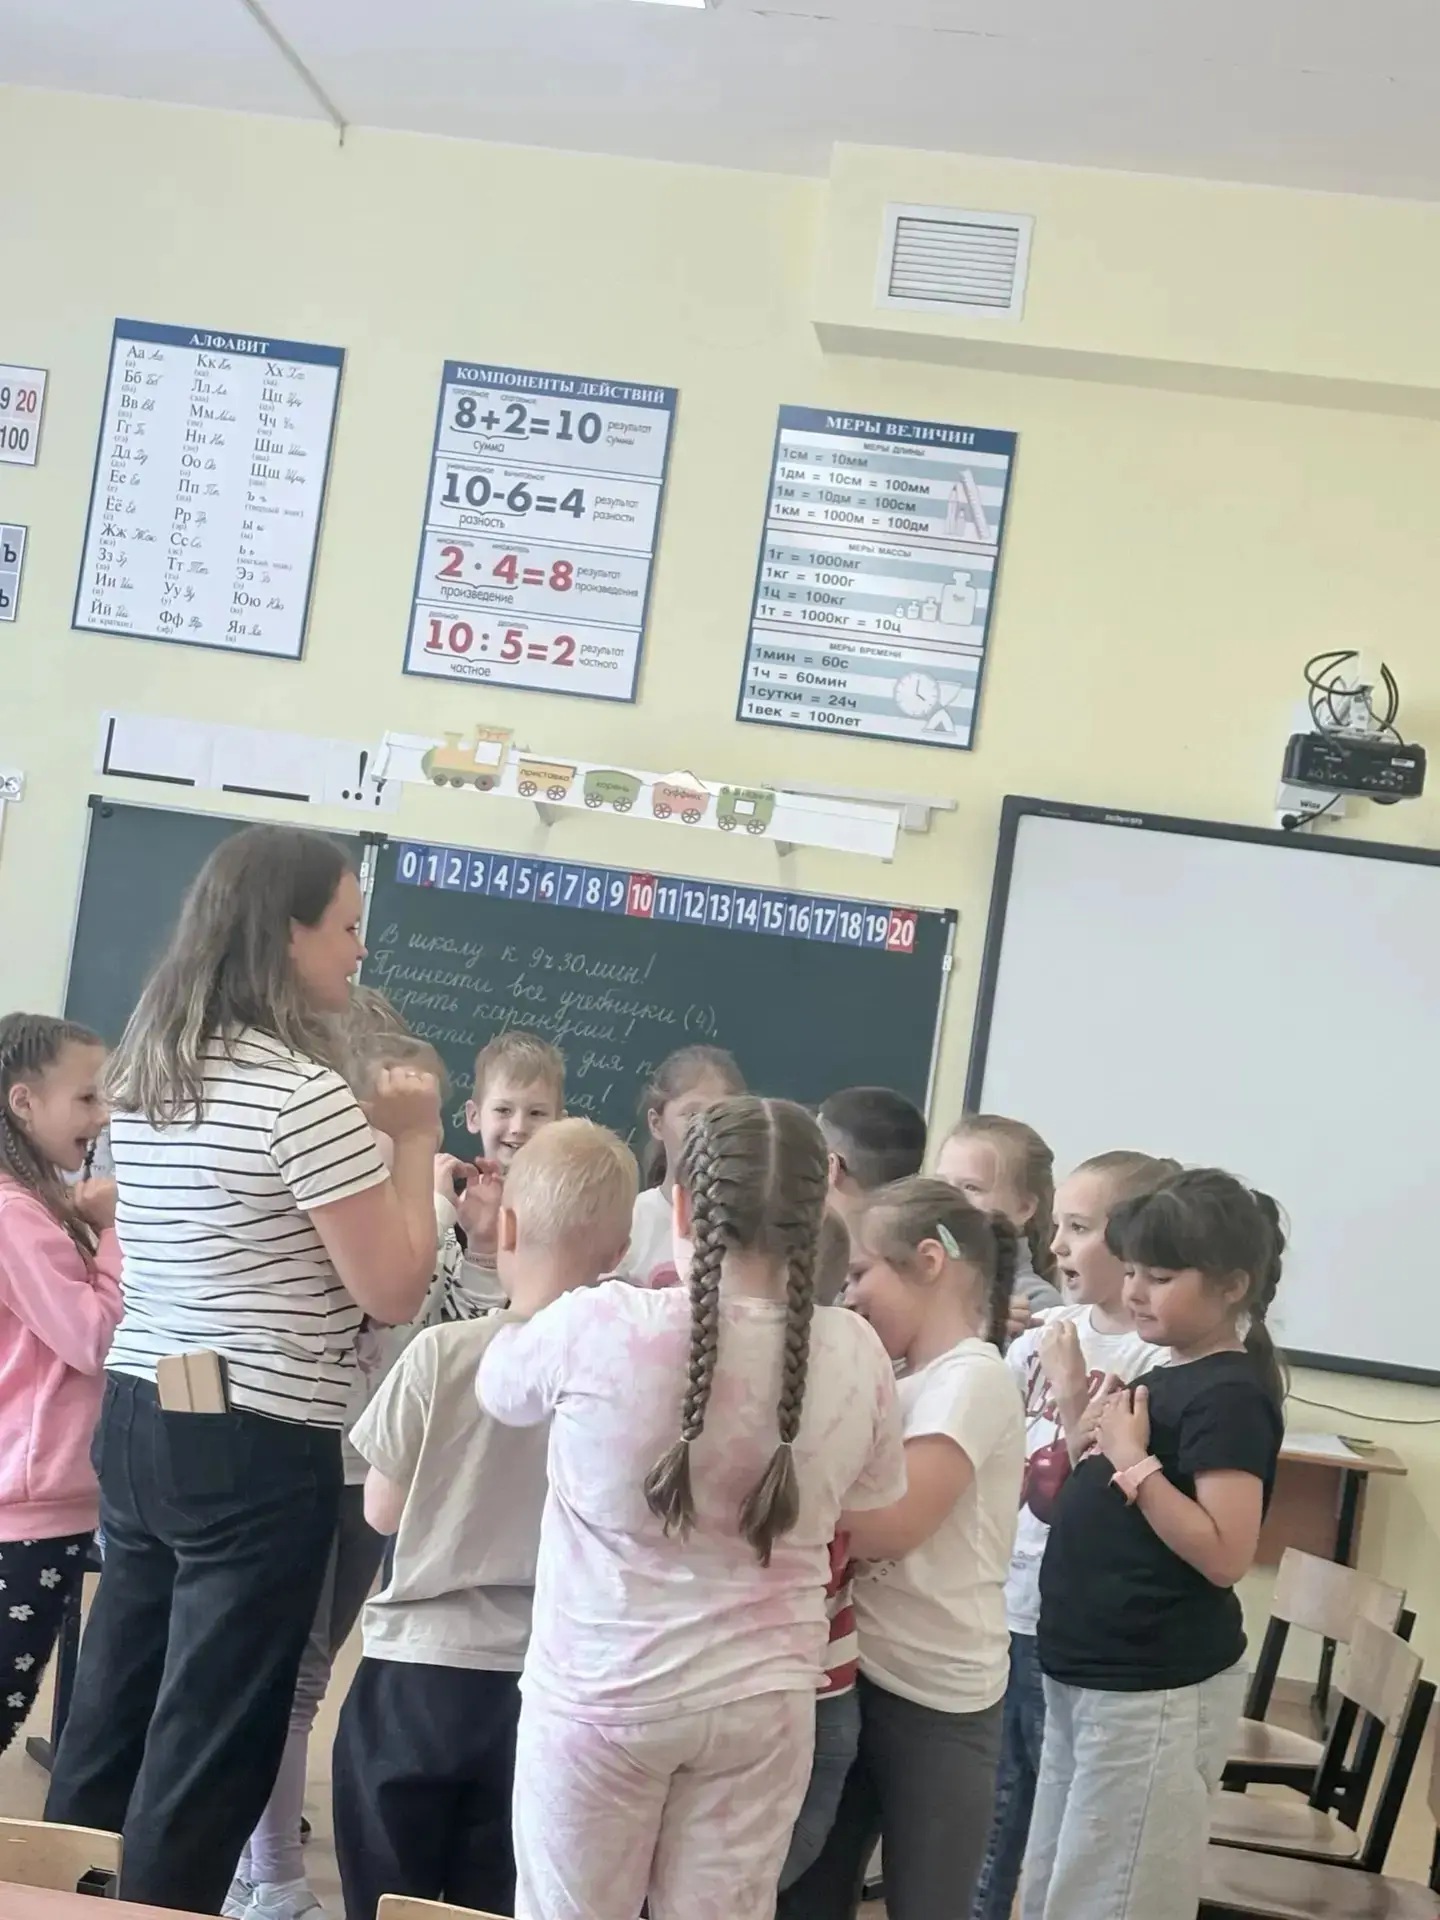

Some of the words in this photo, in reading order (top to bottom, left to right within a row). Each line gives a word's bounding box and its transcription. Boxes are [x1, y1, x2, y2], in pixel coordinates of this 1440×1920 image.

[188, 334, 270, 354] АЛФАВИТ
[127, 346, 144, 358] Аа
[197, 354, 216, 368] Кк
[124, 369, 142, 384] Бб
[265, 363, 284, 377] Хх
[192, 379, 210, 393] Лл
[456, 367, 574, 392] КОМПОНЕНТЫ
[577, 383, 665, 404] ДЕЙСТВИЙ
[16, 389, 36, 413] 20
[121, 394, 138, 409] Вв
[262, 388, 282, 403] Цц
[190, 404, 213, 419] Мм
[116, 420, 132, 434] Гг
[259, 413, 276, 428] Чч
[608, 420, 652, 434] результат
[186, 428, 205, 444] Нн
[826, 416, 881, 434] МЕРЫ
[886, 424, 975, 445] ВЕЛИЧИН
[112, 444, 130, 459] Дд
[255, 438, 282, 453] Шш
[474, 439, 504, 452] сумма
[864, 443, 889, 452] МЕРЫ
[182, 454, 201, 468] Оо
[783, 448, 808, 460] 1см
[832, 453, 868, 468] 10мм
[110, 469, 126, 484] Ее
[780, 467, 805, 480] 1дм
[829, 472, 862, 486] 10см
[886, 479, 930, 494] 100мм
[179, 479, 199, 494] Пп
[106, 495, 122, 512] Ёё
[595, 494, 638, 508] результат
[777, 486, 794, 498] 1м
[819, 490, 851, 504] 10дм
[875, 497, 916, 512] 100см
[174, 508, 191, 524] Рр
[459, 514, 505, 528] разность
[593, 510, 634, 522] разности
[774, 504, 800, 516] 1км
[824, 510, 864, 524] 1000м
[888, 517, 929, 532] 100дм
[101, 523, 127, 538] Жж
[171, 532, 188, 546] Сс
[98, 548, 113, 562] Зз
[849, 544, 875, 554] МЕРЫ
[878, 547, 912, 558] МАССЫ
[168, 557, 184, 571] Тт
[768, 548, 784, 560] 1г
[808, 554, 861, 570] 1000мг
[96, 572, 116, 587] Ии
[236, 567, 254, 580] Ээ
[577, 566, 620, 579] результат
[766, 568, 789, 580] 1кг
[815, 572, 855, 587] 1000г
[164, 582, 181, 598] Уу
[441, 586, 514, 604] произведение
[576, 581, 638, 597] произведения
[764, 586, 780, 599] 1ц
[806, 591, 845, 606] 100кг
[91, 598, 112, 615] Йй
[233, 592, 261, 607] Юю
[160, 611, 183, 628] Фф
[760, 604, 776, 616] 1т
[802, 609, 850, 626] 1000кг
[876, 618, 901, 633] 10ц
[227, 620, 246, 634] Яя
[580, 643, 624, 656] результат
[830, 642, 856, 652] МЕРЫ
[860, 646, 902, 658] ВРЕМЕНИ
[756, 648, 795, 662] 1мин
[822, 655, 849, 669] 60с
[450, 663, 491, 677] частное
[753, 666, 770, 679] 1ч
[796, 672, 847, 688] 60мин
[750, 685, 802, 702] 1сутки
[828, 694, 856, 709] 24ч
[748, 704, 782, 718] 1век
[809, 711, 862, 727] 100лет
[402, 852, 417, 878] 0
[427, 855, 438, 882] 1
[447, 858, 462, 884] 2
[470, 861, 484, 888] 3
[494, 864, 508, 891] 4
[516, 868, 532, 894] 5
[540, 872, 556, 898] 6
[564, 874, 579, 900] 7
[586, 878, 601, 904] 8
[610, 880, 624, 906] 9
[632, 884, 652, 911] 10
[658, 888, 677, 915] 11
[684, 890, 704, 918] 12
[710, 894, 730, 922] 13
[736, 898, 756, 925] 14
[762, 901, 782, 929] 15
[788, 904, 809, 932] 16
[814, 908, 836, 936] 17
[840, 911, 860, 940] 18
[866, 915, 887, 942] 19
[888, 918, 914, 946] 20
[379, 923, 398, 944] В
[408, 933, 484, 968] школу
[369, 950, 493, 993] Принести
[555, 988, 676, 1024] учебники
[577, 1050, 624, 1078] для
